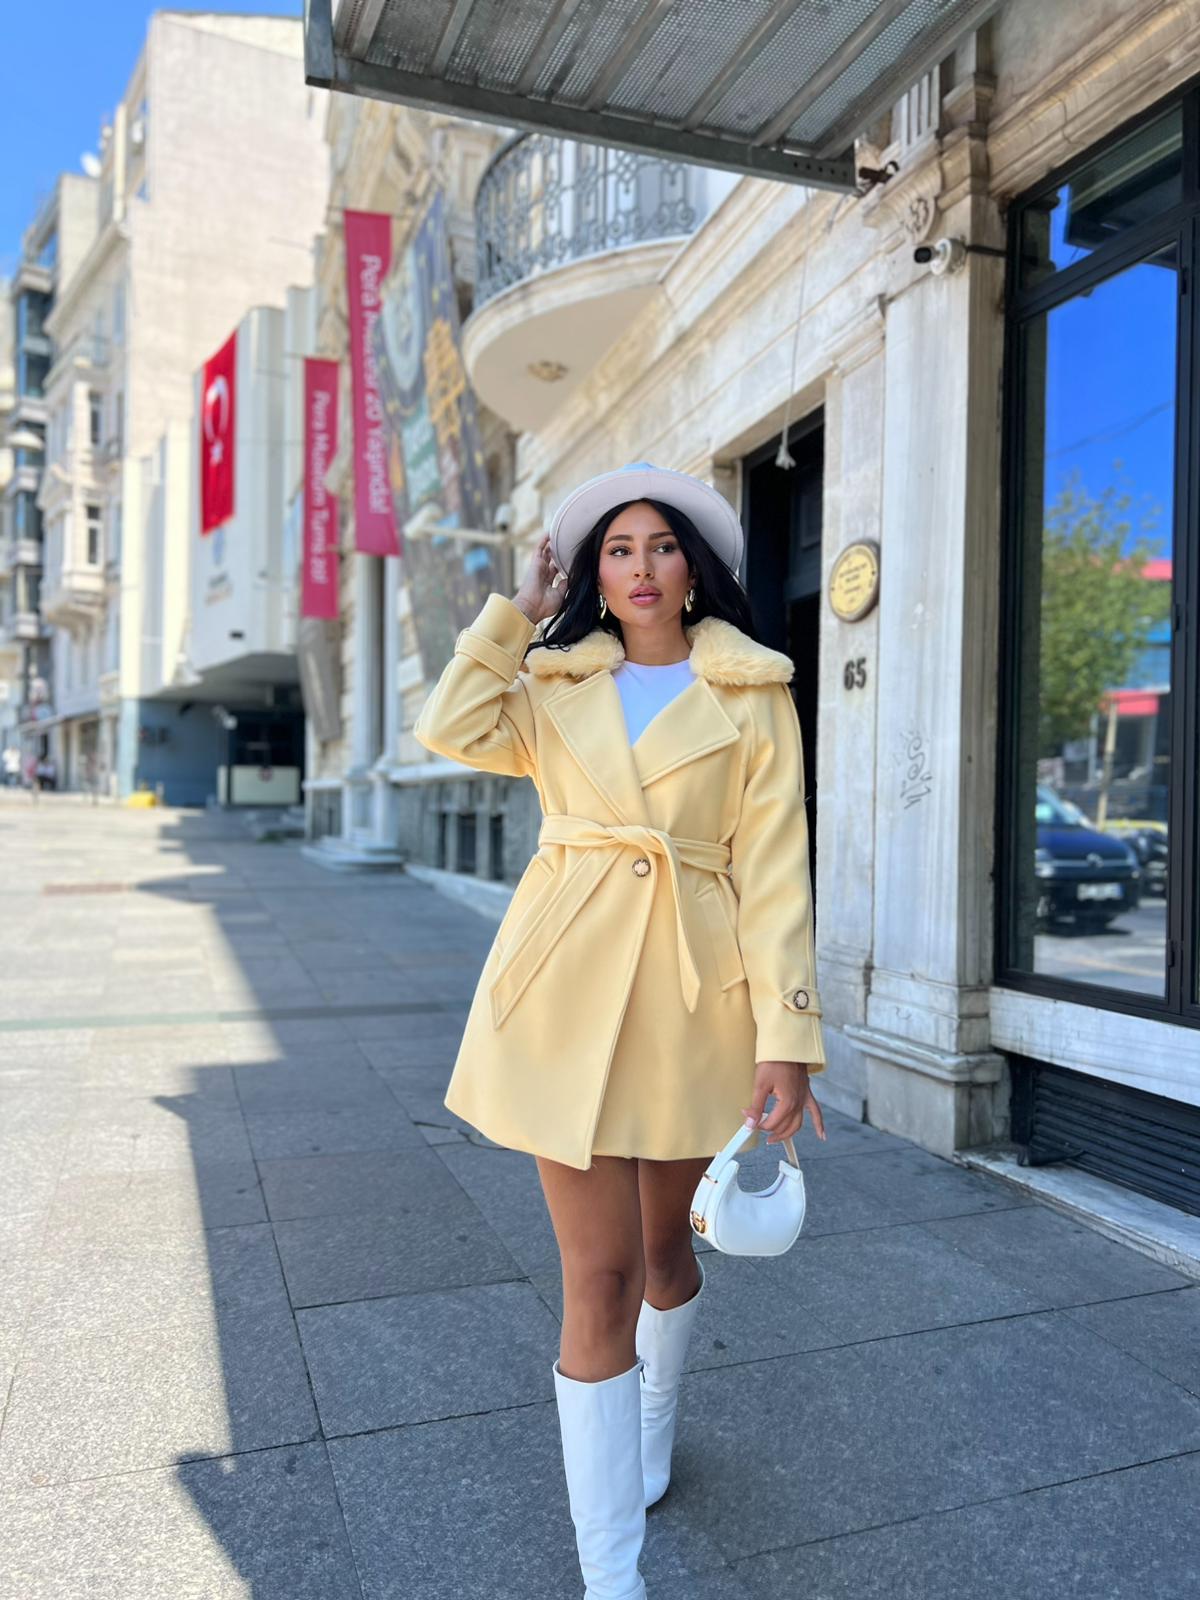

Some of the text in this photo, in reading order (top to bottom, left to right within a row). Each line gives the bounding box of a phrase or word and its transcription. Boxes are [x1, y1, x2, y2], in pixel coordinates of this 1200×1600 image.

[360, 254, 382, 307] Pera
[311, 390, 331, 431] Pera
[365, 392, 383, 421] 20
[311, 433, 330, 507] Museum
[363, 427, 390, 514] Yaşında!
[311, 511, 330, 554] Turns
[843, 656, 867, 690] 65
